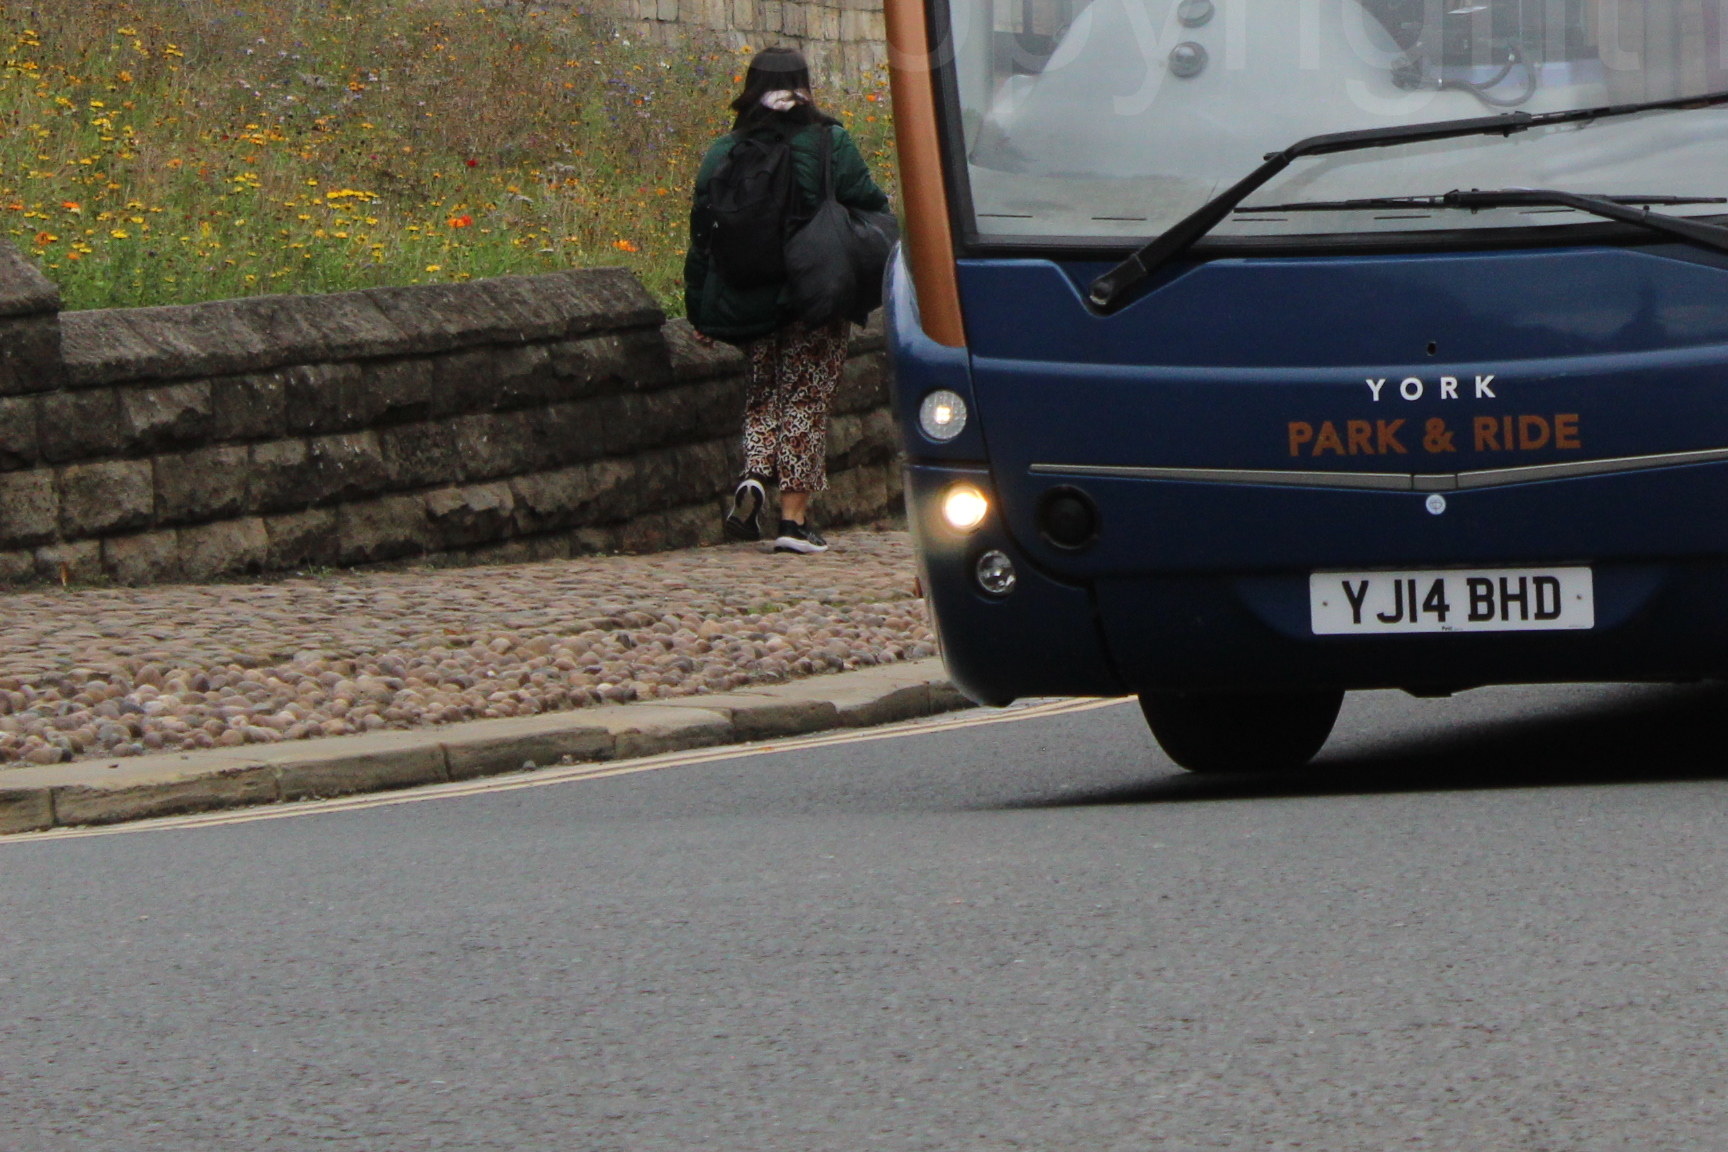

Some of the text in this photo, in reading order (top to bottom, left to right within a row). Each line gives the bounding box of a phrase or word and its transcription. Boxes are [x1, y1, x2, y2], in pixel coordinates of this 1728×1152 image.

[1365, 374, 1496, 402] YORK
[1288, 413, 1583, 457] PARK & RIDE
[1341, 575, 1563, 625] YJ14 BHD
